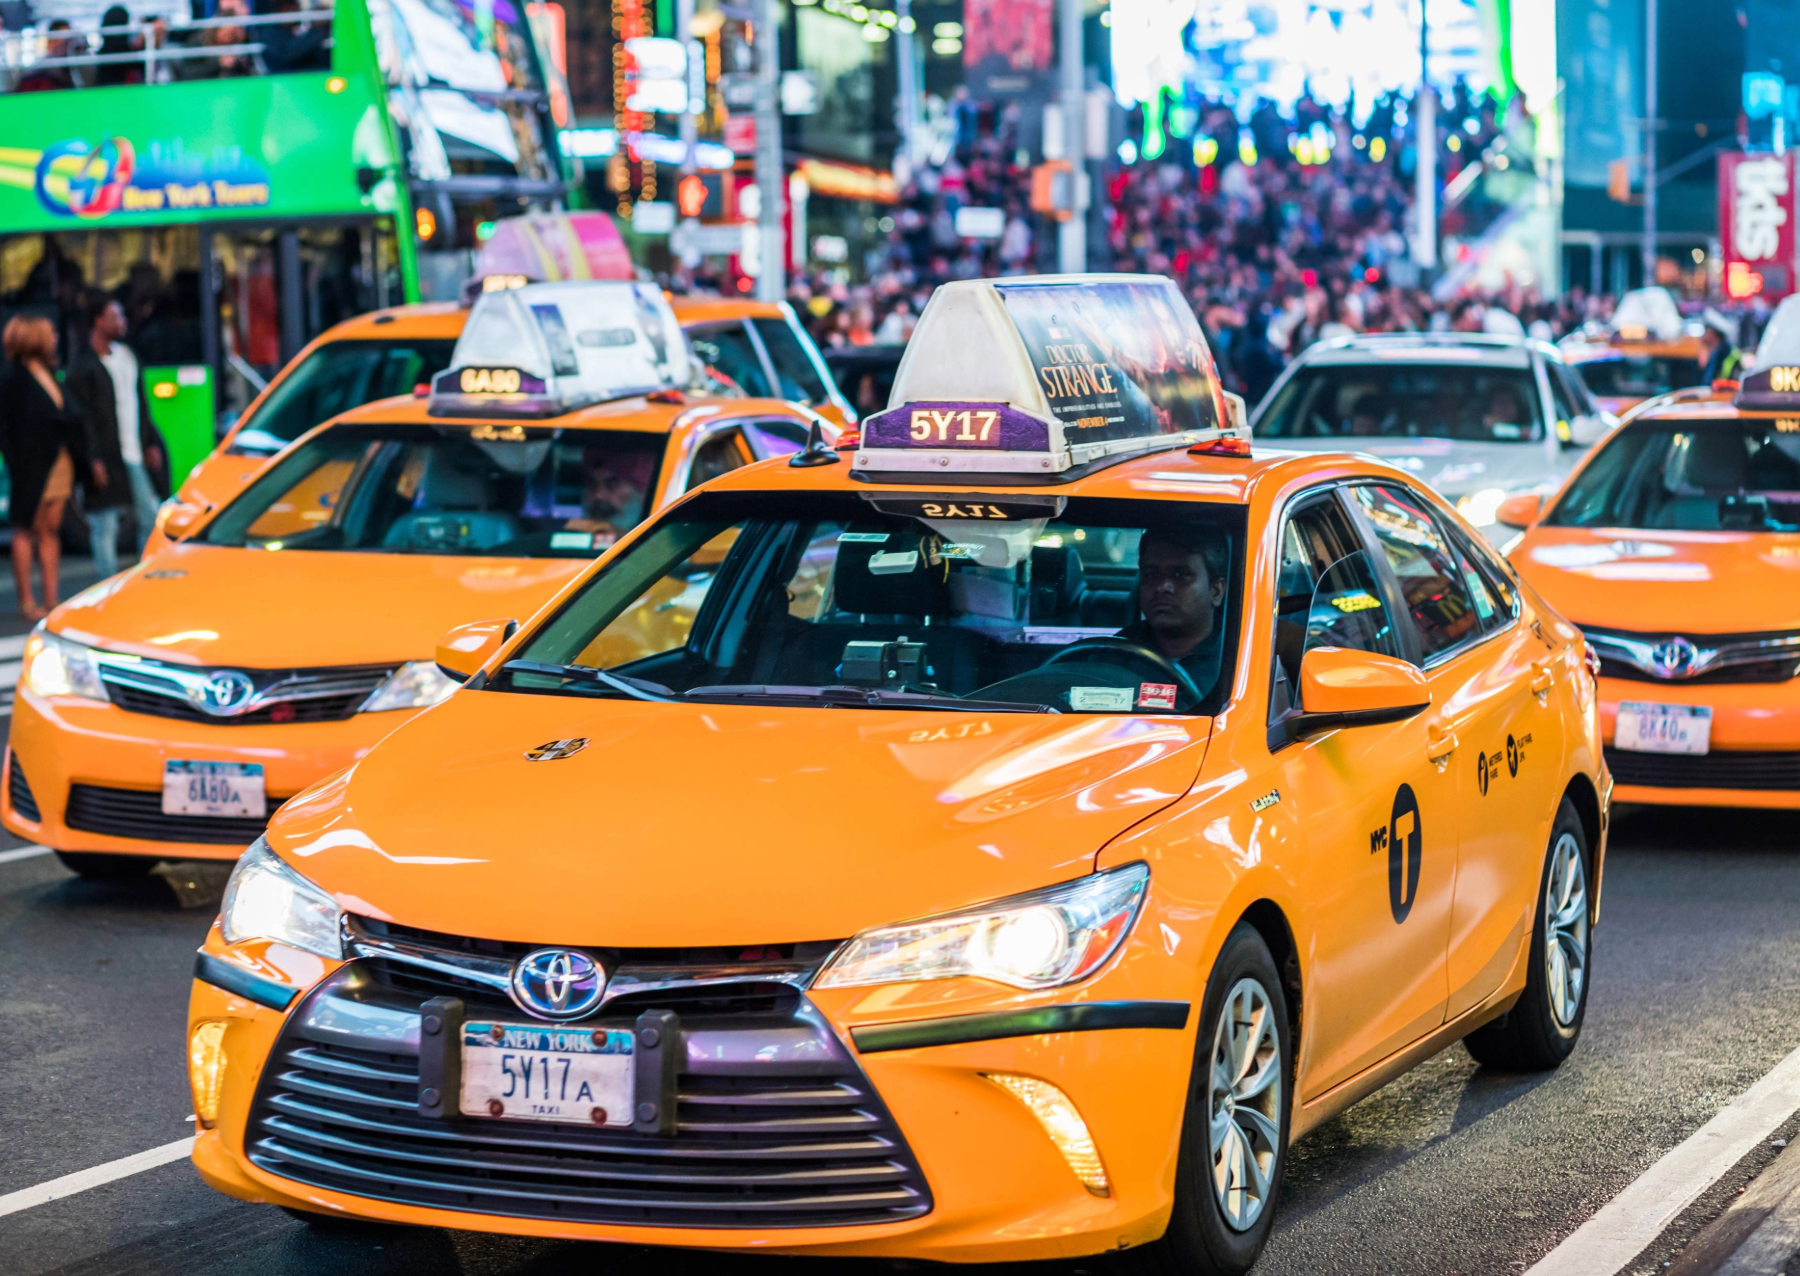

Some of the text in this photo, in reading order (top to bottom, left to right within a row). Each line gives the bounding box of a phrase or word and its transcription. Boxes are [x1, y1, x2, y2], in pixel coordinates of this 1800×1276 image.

[1045, 344, 1092, 364] DOCTOR
[460, 368, 520, 393] 6A80
[1041, 363, 1118, 398] STRANGE
[910, 410, 997, 441] 5Y17
[1370, 825, 1387, 855] NYC
[504, 1030, 593, 1053] NEW YORK
[532, 1104, 560, 1115] TAXI
